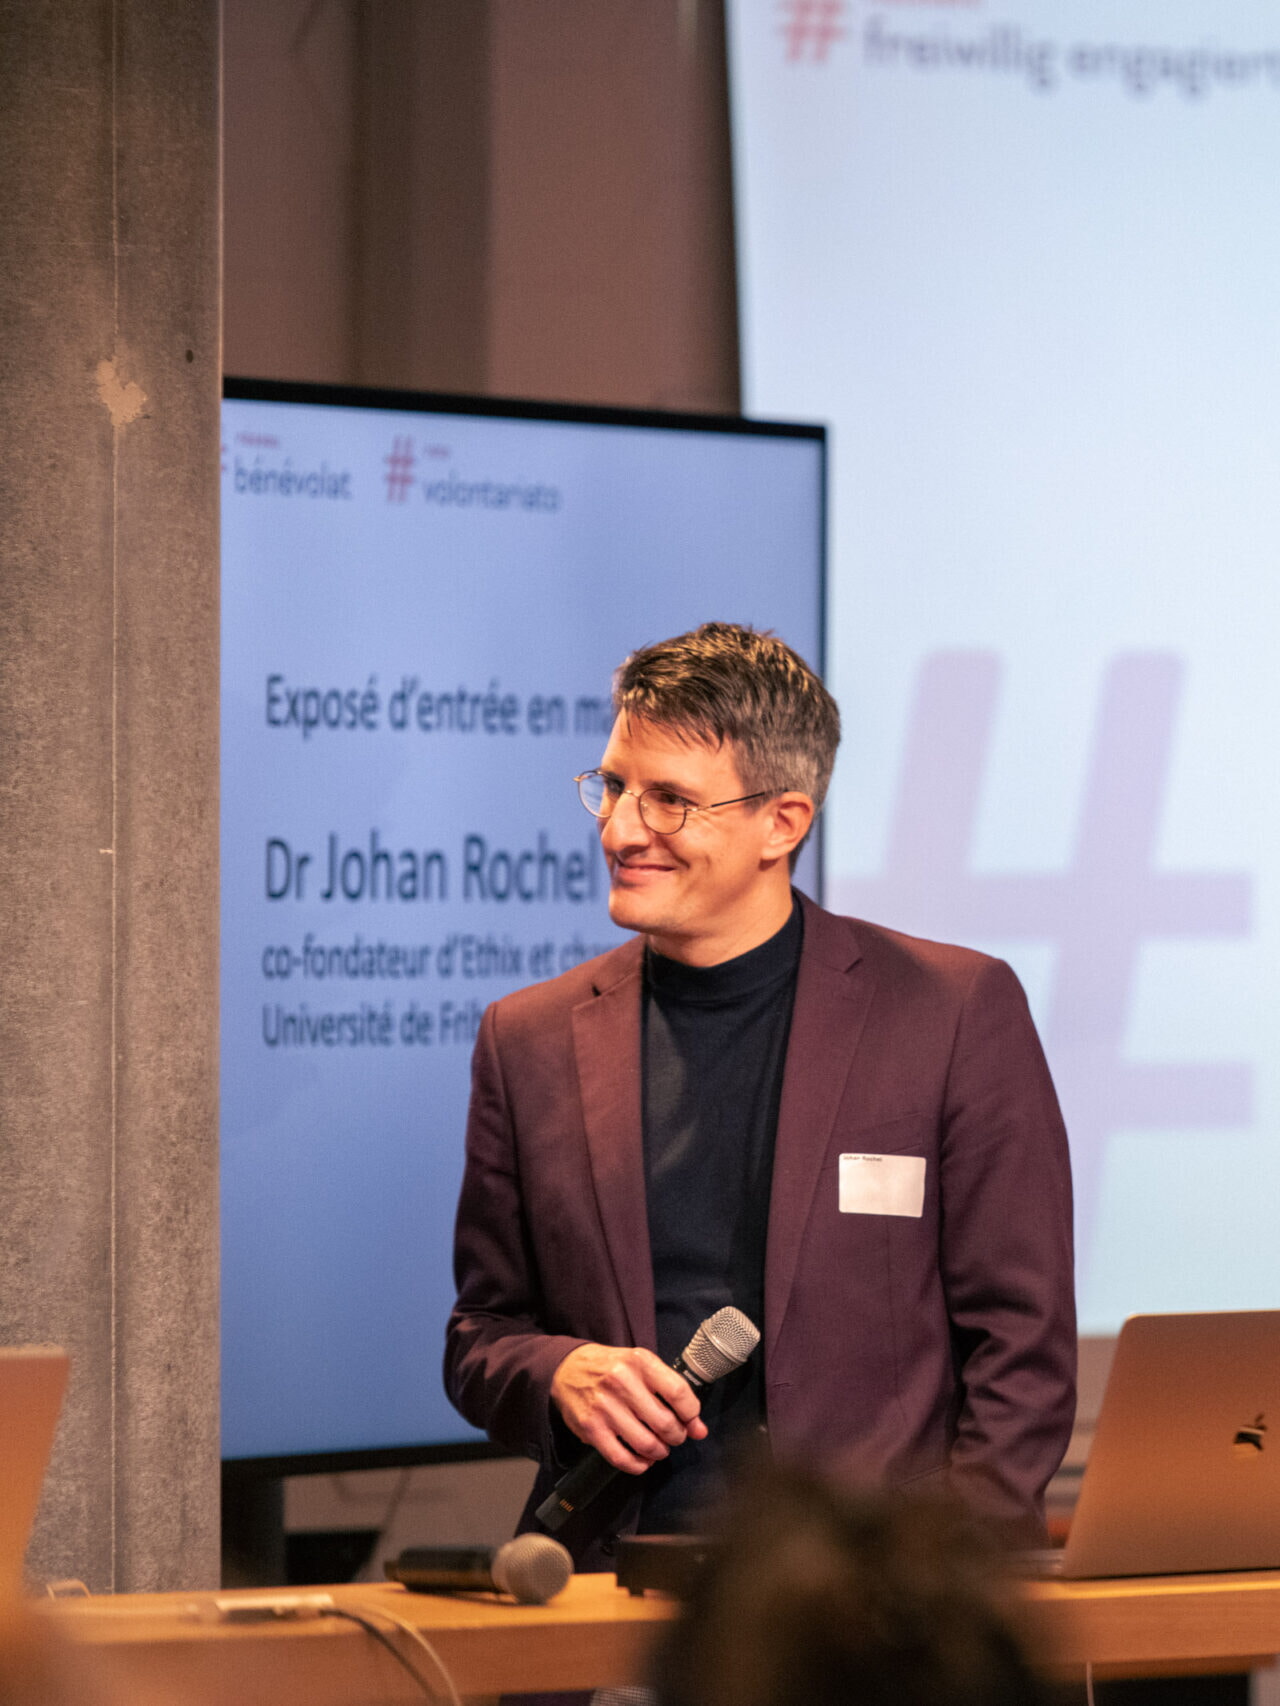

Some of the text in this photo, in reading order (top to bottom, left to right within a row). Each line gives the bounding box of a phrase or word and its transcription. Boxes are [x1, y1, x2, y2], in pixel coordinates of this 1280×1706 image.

[234, 456, 352, 500] bénévolat
[424, 472, 560, 514] volontariato
[266, 674, 612, 740] Exposé d'entrée en ma
[266, 830, 598, 902] Dr Johan Rochel
[262, 934, 432, 980] co-fondateur
[436, 934, 521, 980] d'Ethix
[528, 940, 556, 978] et
[262, 1002, 394, 1048] Université
[400, 1002, 438, 1046] de
